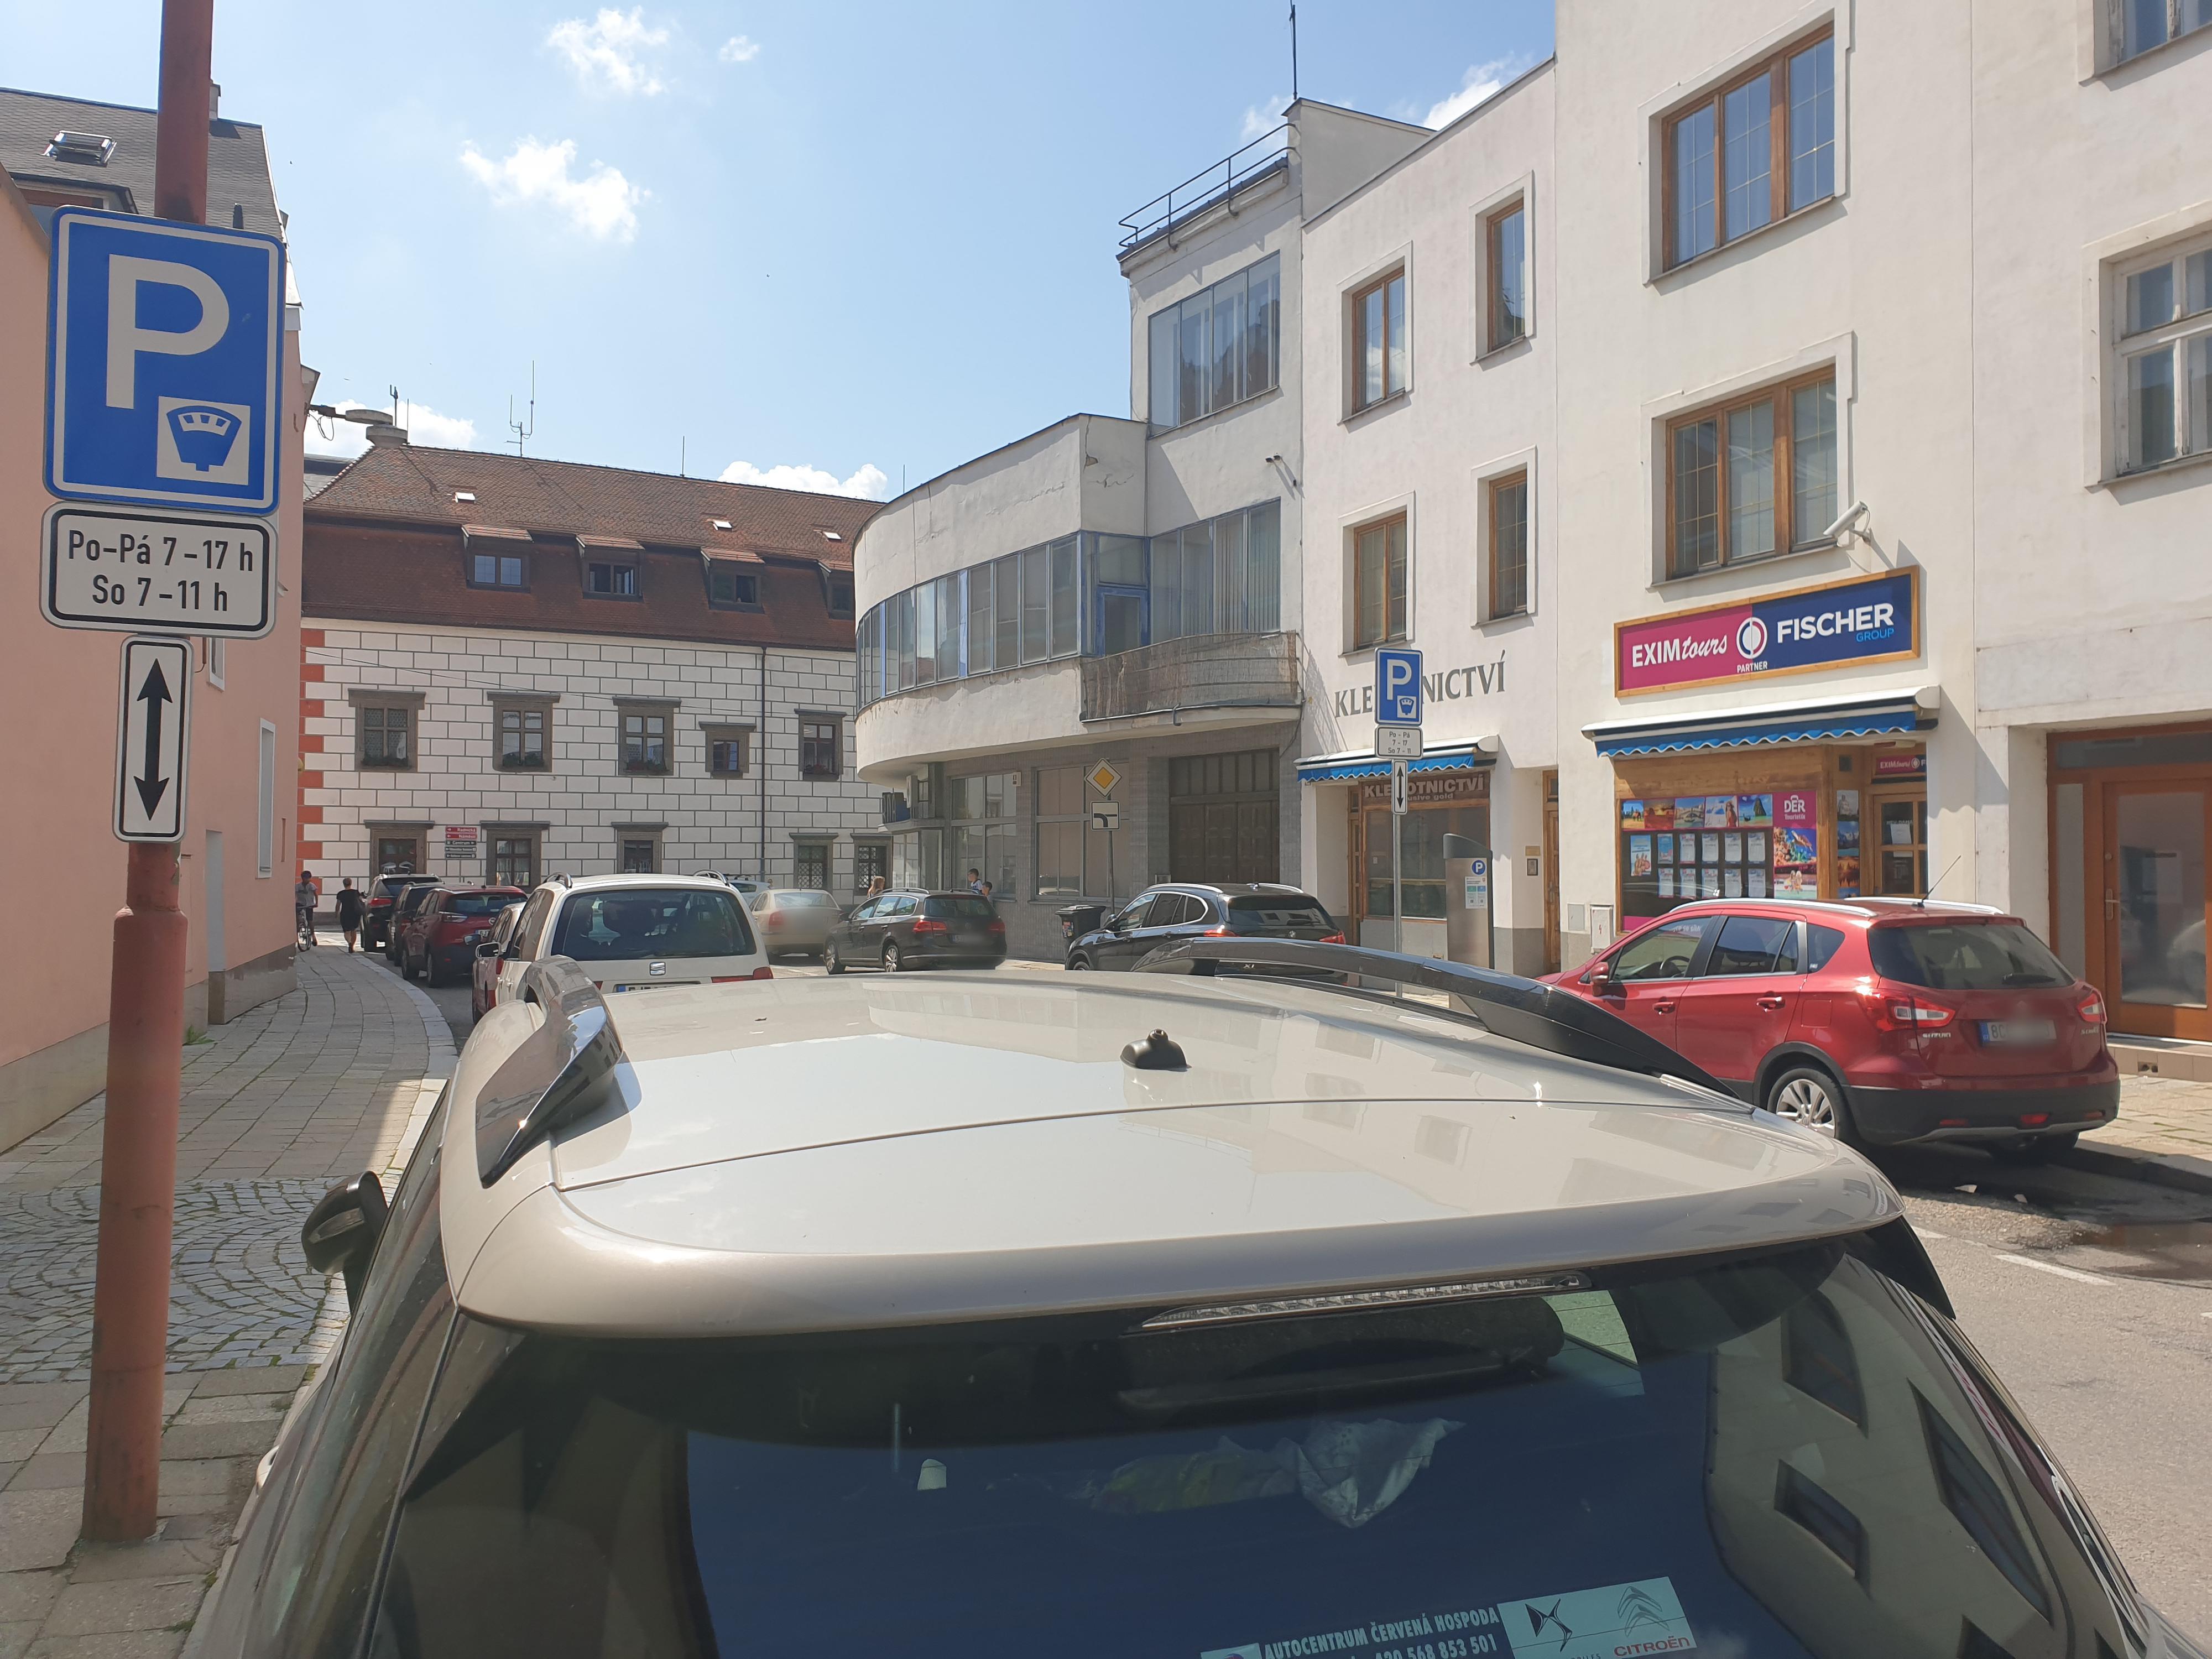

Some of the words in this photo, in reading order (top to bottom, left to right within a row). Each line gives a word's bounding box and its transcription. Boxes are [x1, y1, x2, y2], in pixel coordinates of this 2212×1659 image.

[106, 254, 230, 410] P
[239, 542, 253, 571] h
[92, 574, 125, 605] So
[214, 582, 228, 611] h
[1777, 602, 1894, 644] FISCHER
[1856, 628, 1895, 643] GROUP
[1386, 659, 1412, 701] P
[1737, 660, 1768, 674] PARTNER
[1334, 649, 1505, 718] KLENICTVÍ
[1364, 774, 1484, 798] KLEOTNICTVÍ
[1784, 799, 1806, 813] DER
[1475, 862, 1483, 873] P
[1265, 1627, 1369, 1659] AUTOCENTRUM
[1370, 1613, 1433, 1643] ČERVENÁ
[1433, 1607, 1500, 1632] HOSPODA
[1407, 1644, 1436, 1659] 568
[1438, 1638, 1467, 1659] 853
[1469, 1633, 1498, 1655] 501
[1614, 1635, 1691, 1657] CITROËN
